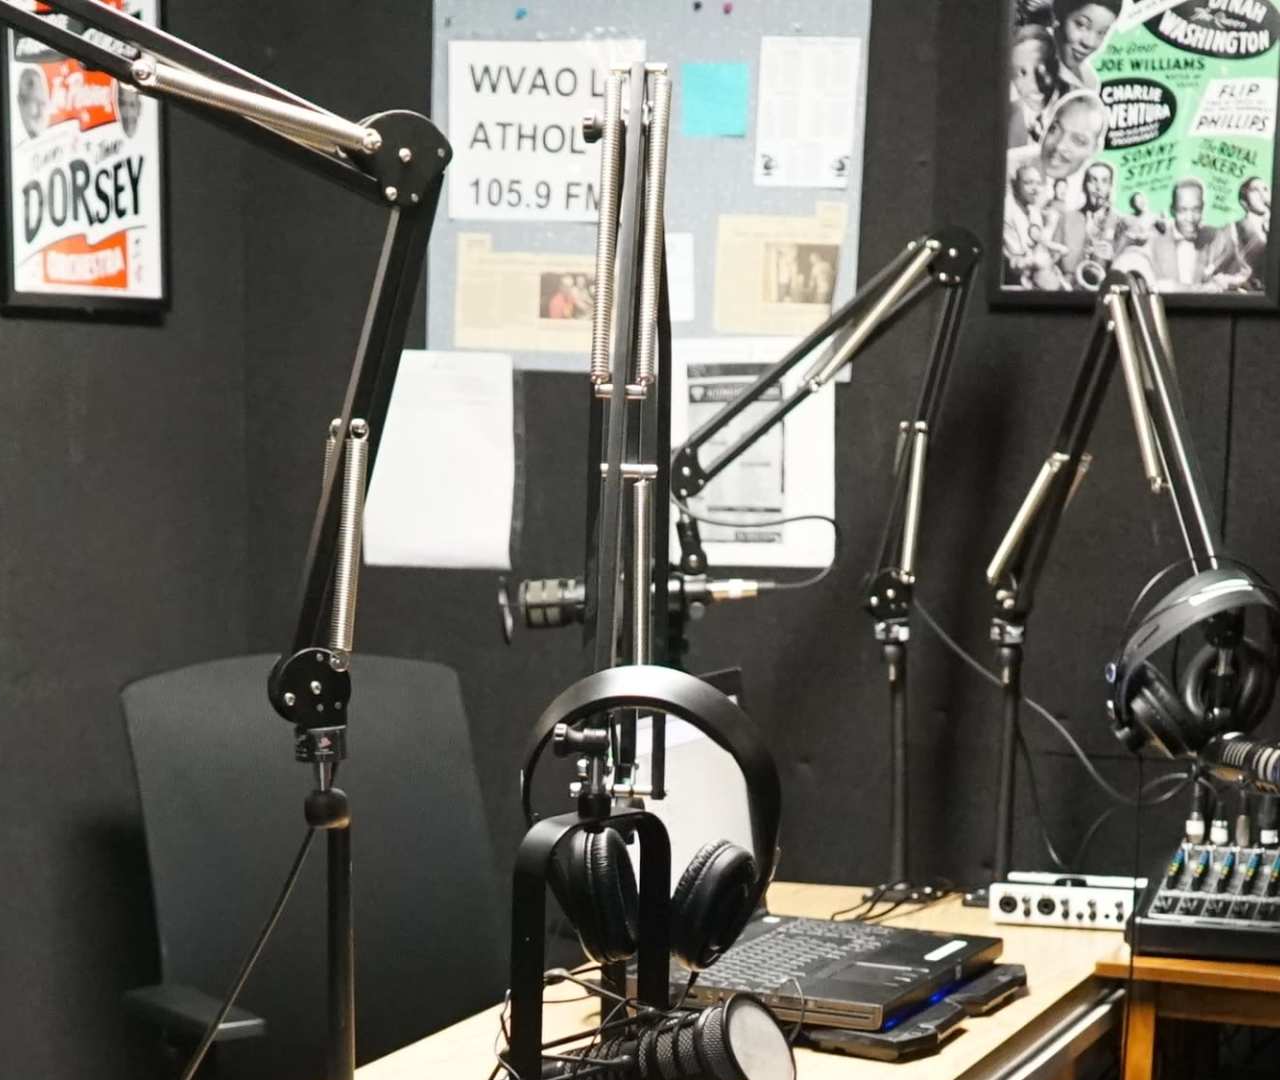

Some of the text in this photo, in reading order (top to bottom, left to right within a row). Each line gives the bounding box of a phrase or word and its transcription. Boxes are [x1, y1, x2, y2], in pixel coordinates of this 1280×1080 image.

[1158, 9, 1270, 54] WASHINGTON
[470, 63, 577, 97] WVAO
[1096, 57, 1206, 72] JOE WILLIAMS
[1101, 83, 1164, 105] CHARLIE
[1219, 82, 1261, 98] FLIP
[470, 121, 586, 154] ATHOL
[1196, 115, 1270, 132] PHILLIPS
[22, 155, 144, 244] DORSEY
[470, 177, 552, 210] 105.9
